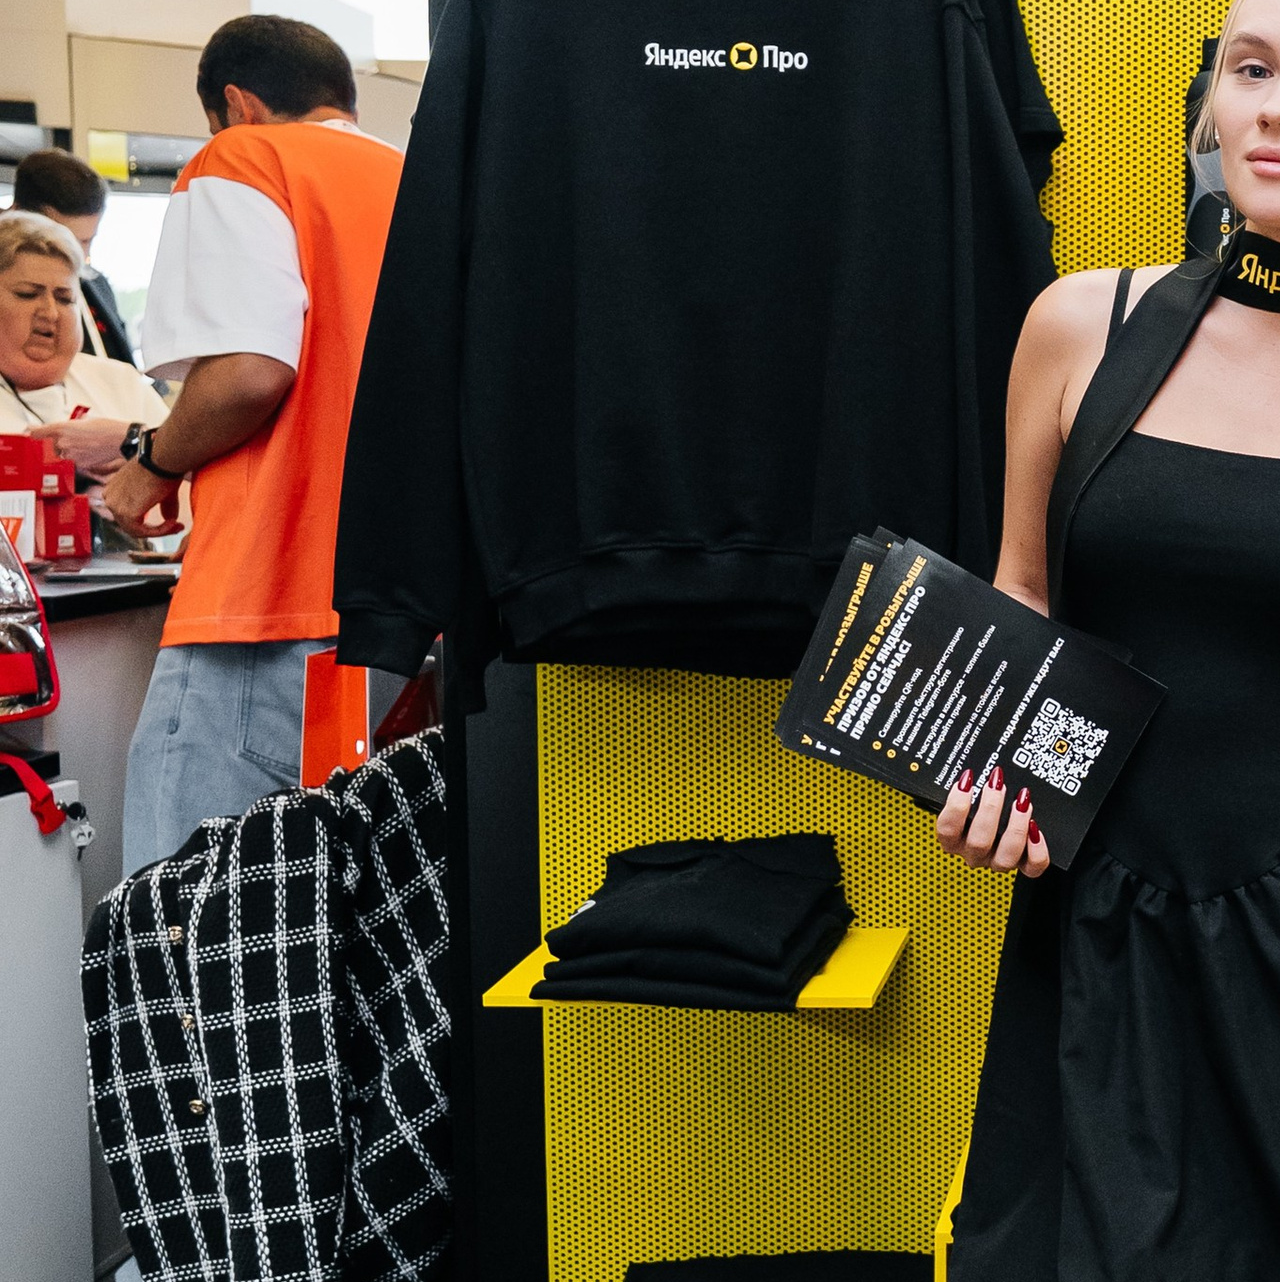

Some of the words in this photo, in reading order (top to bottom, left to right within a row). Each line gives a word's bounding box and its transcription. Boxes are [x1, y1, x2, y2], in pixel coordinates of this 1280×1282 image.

[645, 42, 727, 70] Яндекс
[763, 44, 809, 73] Про
[874, 555, 927, 635] РОЗЫГРЫШЕ
[836, 680, 872, 733] ПРИЗОВ
[866, 661, 881, 681] ОТ
[876, 611, 911, 664] ЯНДЕКС
[903, 585, 926, 614] ПРО
[868, 634, 881, 645] В
[823, 643, 876, 725] УЧАСТВУЙТЕ
[849, 693, 881, 740] ПРЯМО
[876, 639, 912, 694] СЕЙЧАС!
[878, 694, 907, 738] Сканируйте
[902, 667, 923, 695] QR-код
[892, 706, 919, 746] Проходите
[914, 674, 937, 707] быструю
[933, 626, 964, 676] регистрацию
[905, 719, 923, 746] нашем
[917, 669, 952, 720] Telegram-боте
[914, 718, 943, 759] Участвуйте
[941, 678, 965, 713] конкурсе
[964, 647, 983, 674] копите
[977, 624, 996, 648] баллы
[933, 763, 950, 785] Наши
[946, 721, 973, 764] менеджеры
[969, 712, 978, 723] на
[974, 683, 994, 713] стойках
[990, 660, 1008, 685] всегда
[950, 694, 967, 719] призы
[975, 752, 999, 790] ПРОСТО
[998, 701, 1028, 745] ПОДАРКИ
[1022, 682, 1039, 703] УЖЕ
[1033, 656, 1053, 684] ЖДУТ
[1048, 637, 1065, 659] ВАС!
[925, 757, 932, 765] и
[928, 718, 954, 759] выбирайте
[943, 759, 963, 791] помогут
[963, 725, 981, 754] ответят
[978, 716, 987, 727] на
[983, 685, 1005, 717] вопросы
